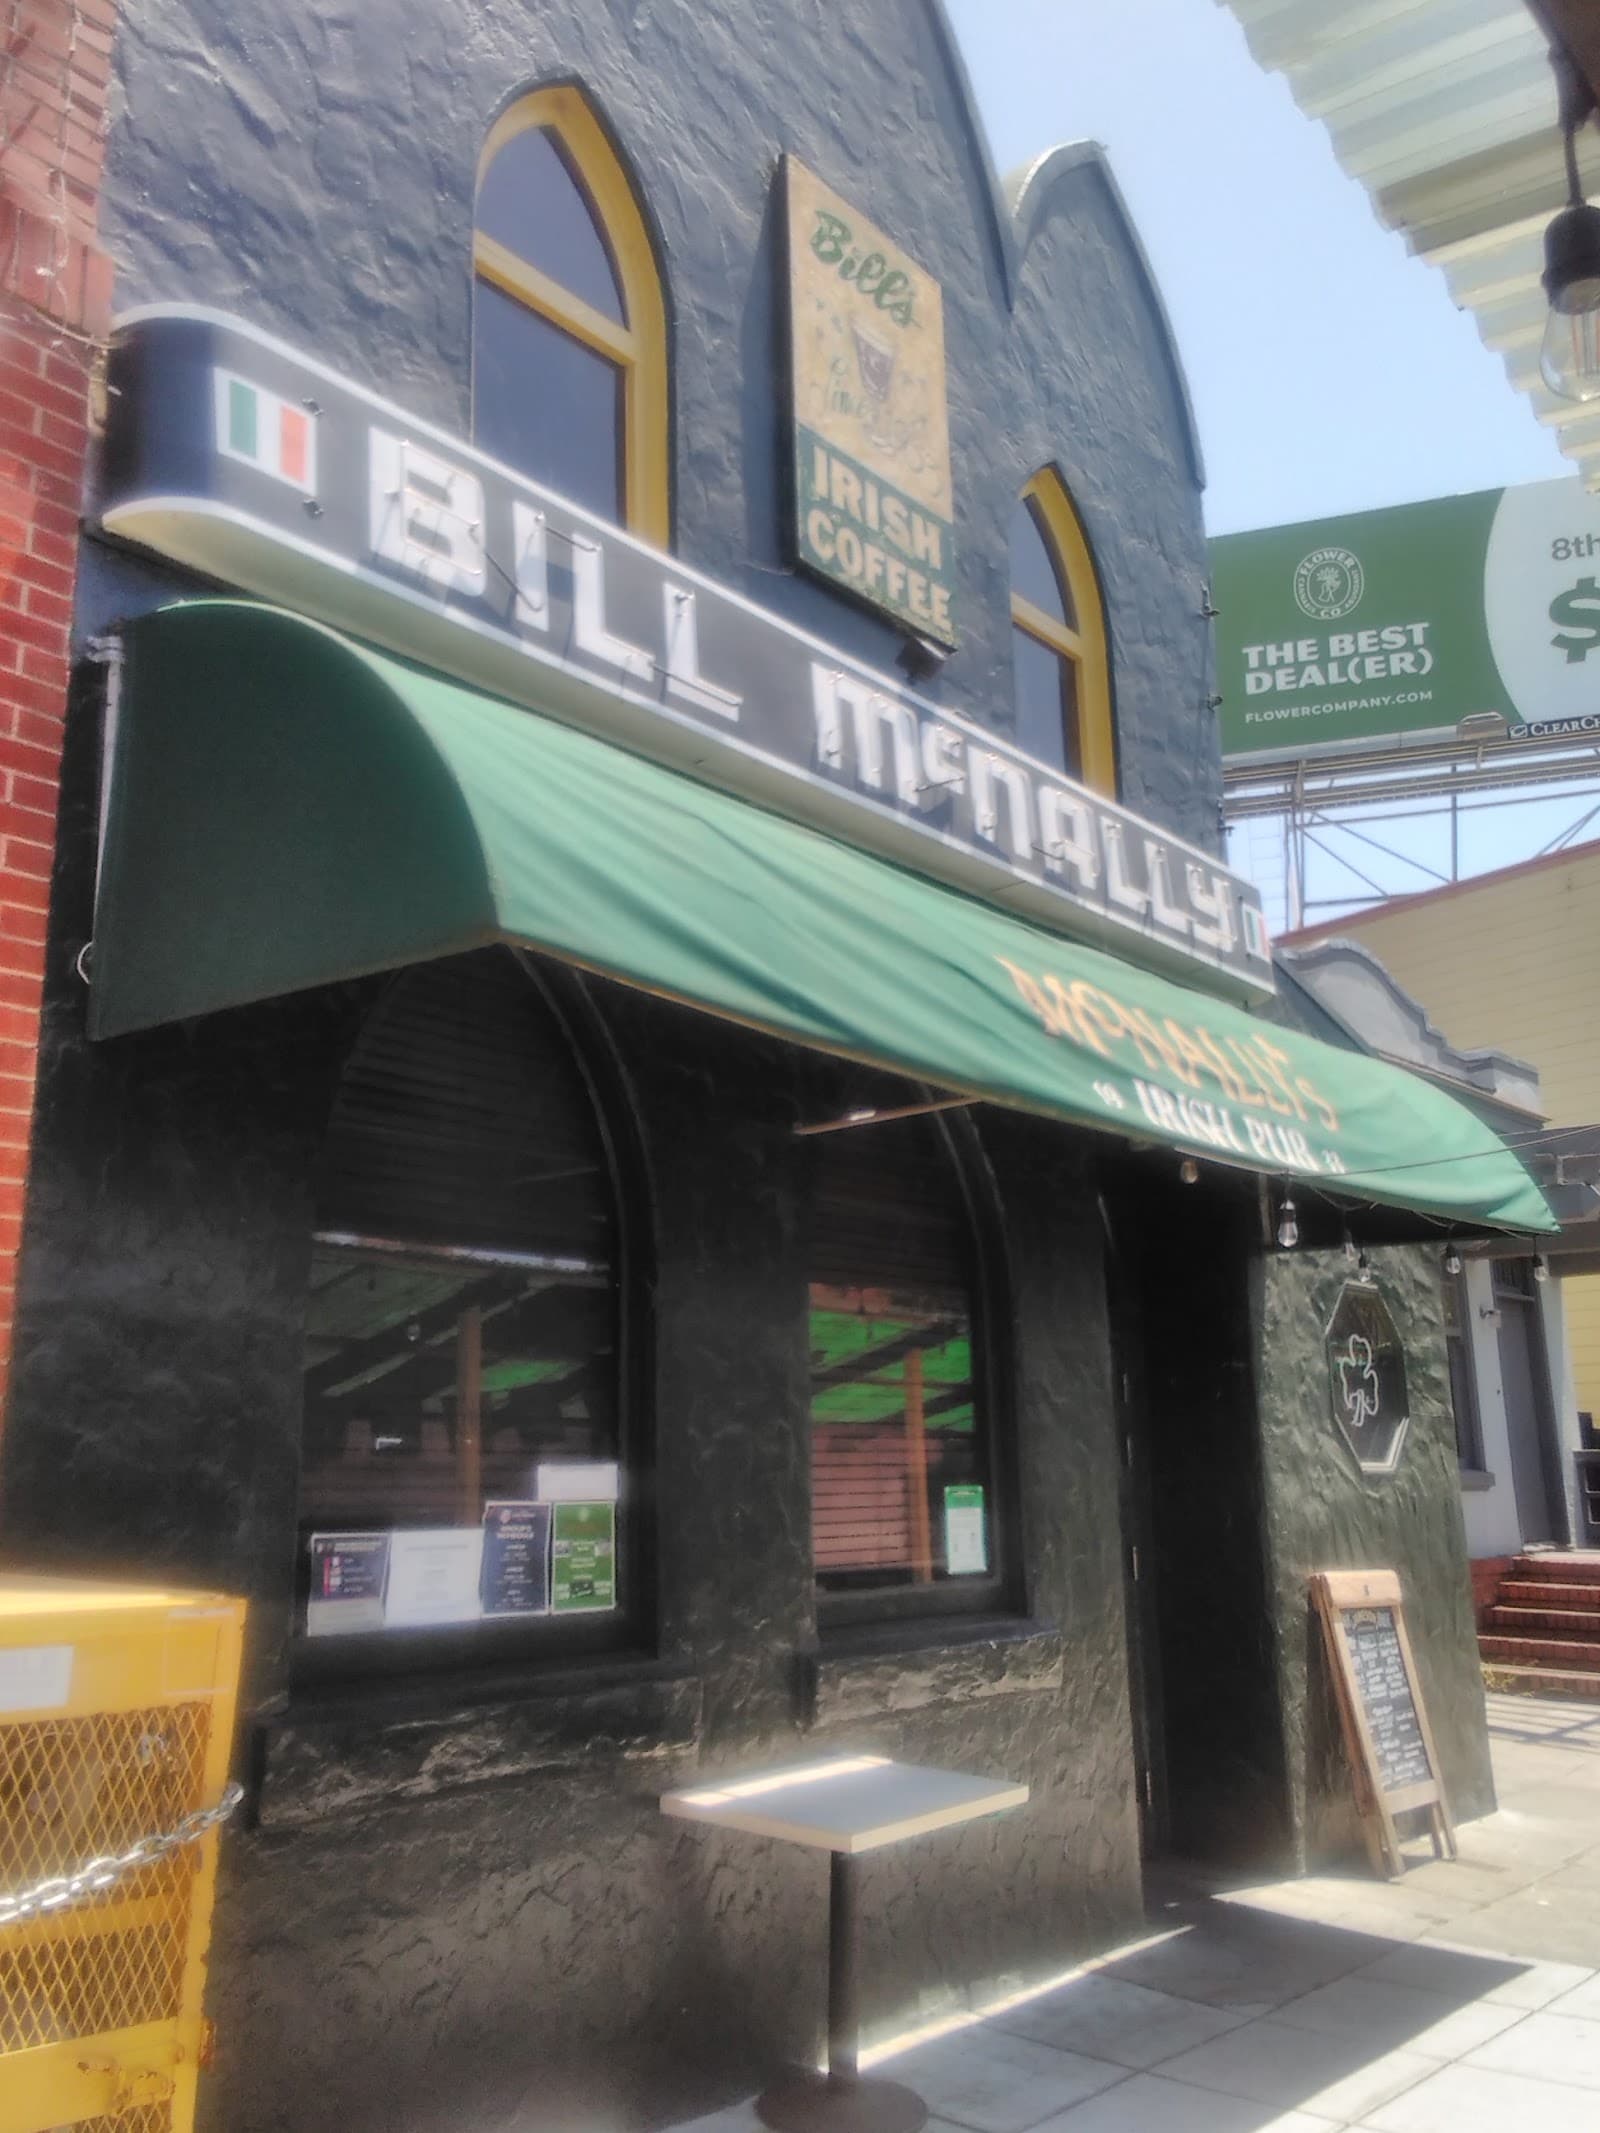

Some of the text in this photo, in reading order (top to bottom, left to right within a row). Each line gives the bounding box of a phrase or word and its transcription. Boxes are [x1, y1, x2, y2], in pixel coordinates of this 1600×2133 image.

[814, 446, 940, 570] IRISH
[368, 422, 742, 722] BILL
[808, 509, 952, 634] COFFEE
[1300, 550, 1356, 576] FLOWER
[1320, 608, 1341, 618] CO
[1242, 622, 1430, 669] THE BEST
[1245, 648, 1434, 695] DEAL(ER)
[1245, 690, 1433, 723] FLOWERCOMPANY.COM
[1132, 1078, 1322, 1172] IRISH PUB
